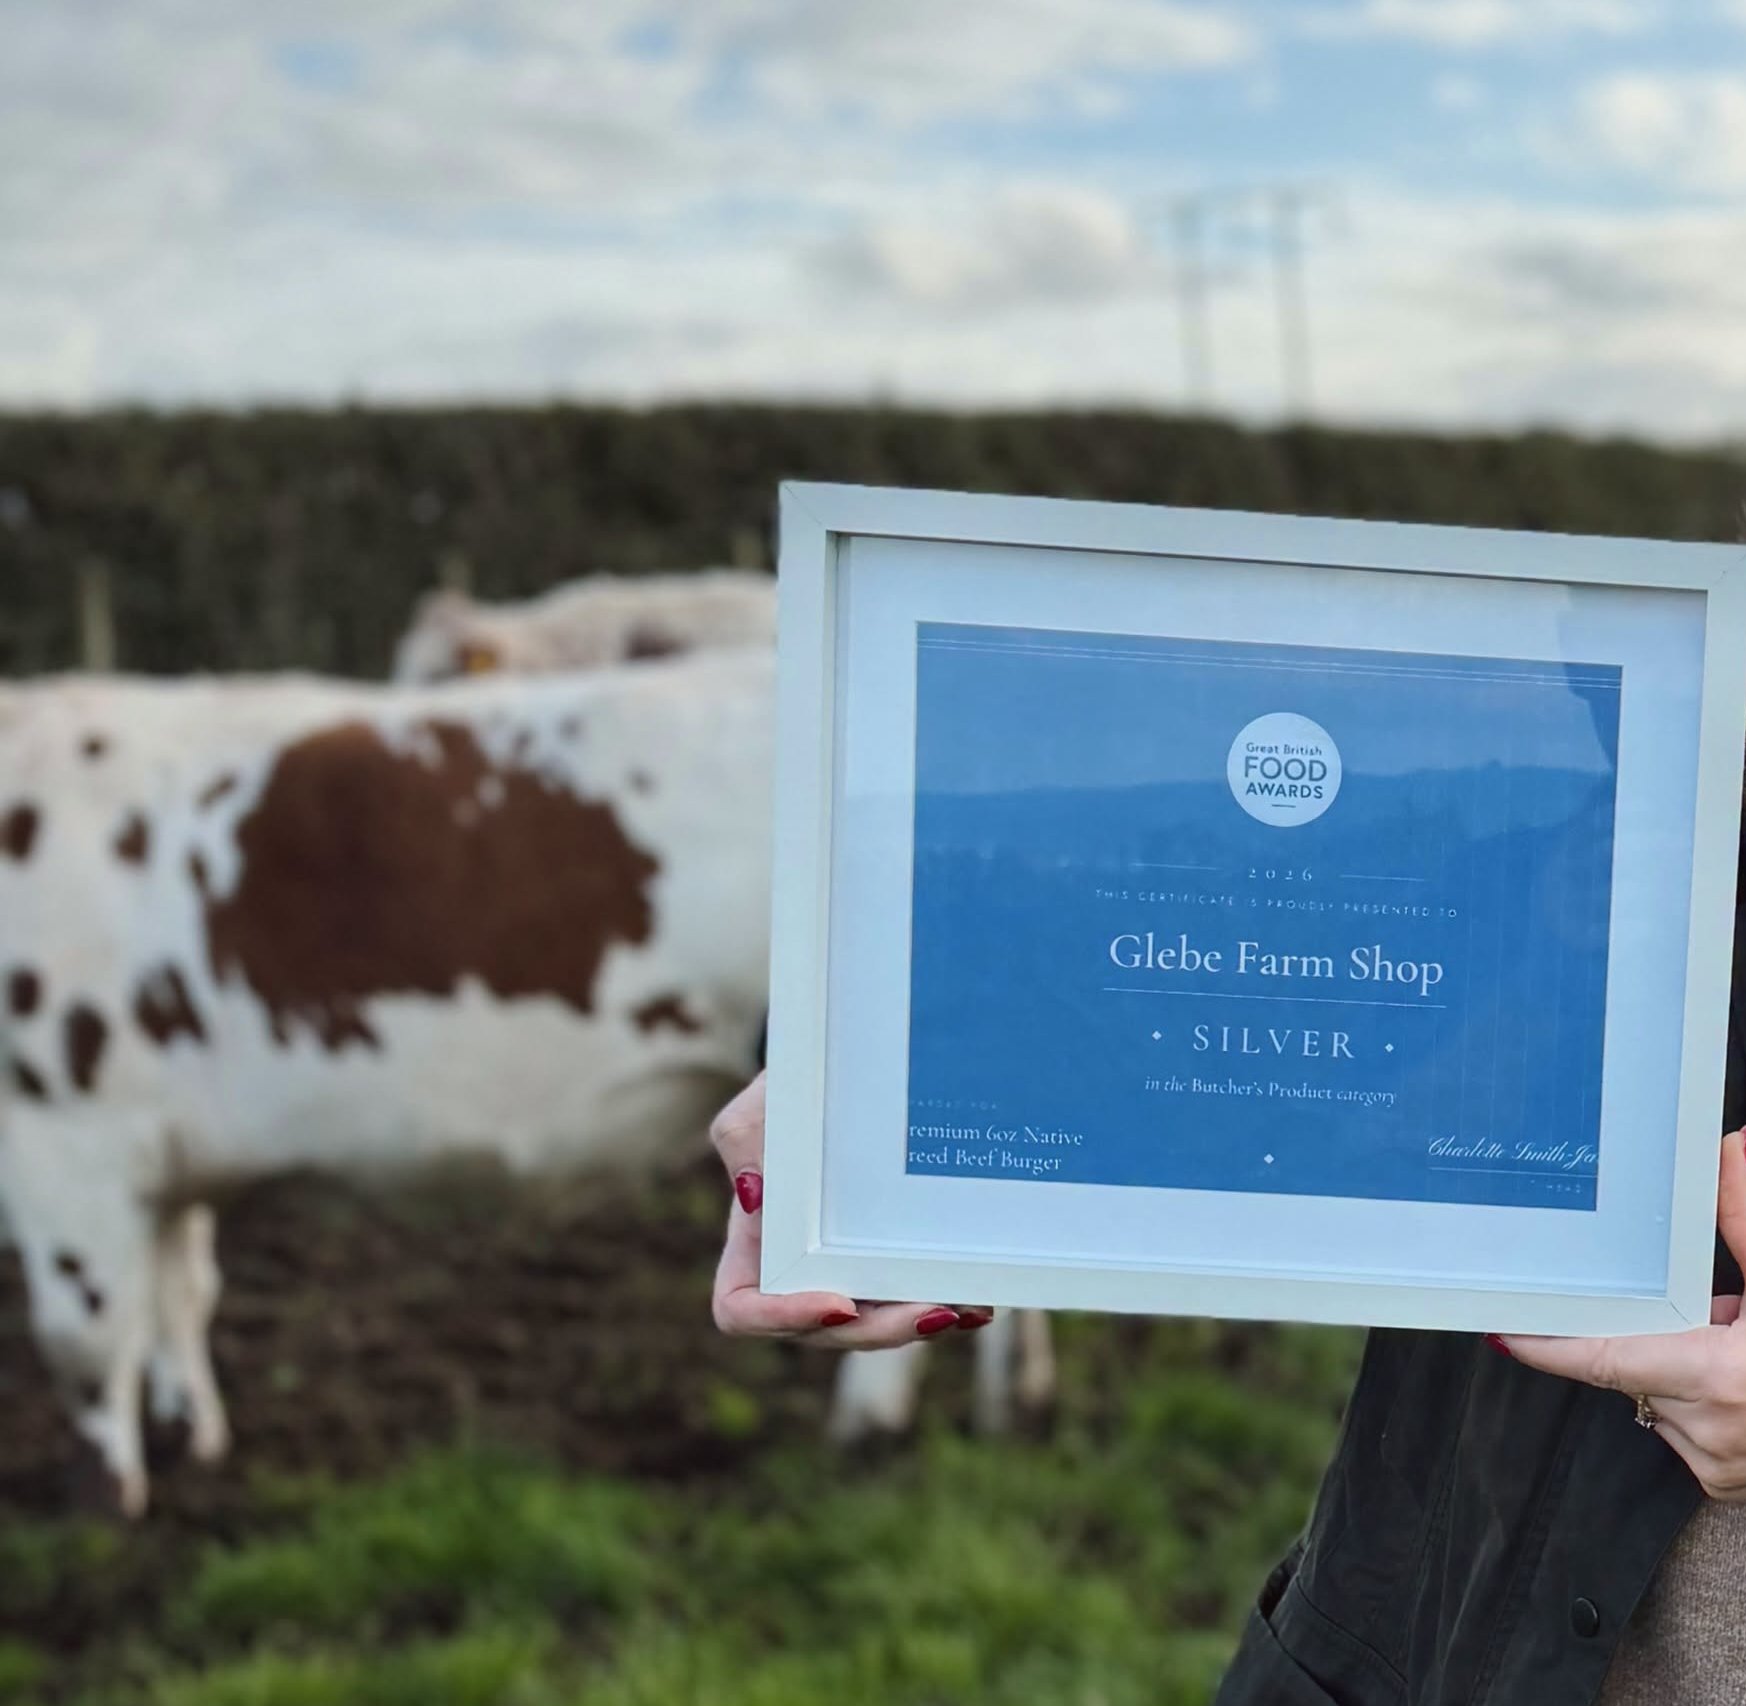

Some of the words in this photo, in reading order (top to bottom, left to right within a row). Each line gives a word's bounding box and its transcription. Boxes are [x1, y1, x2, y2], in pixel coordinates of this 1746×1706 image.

[1246, 742, 1279, 753] Great
[1283, 744, 1323, 756] British
[1244, 755, 1328, 782] FOOD
[1246, 782, 1324, 799] AWARDS
[1249, 868, 1313, 882] 2026
[1095, 888, 1129, 900] THIS
[1110, 932, 1223, 973] Glebe
[1236, 941, 1335, 979] Farm
[1350, 944, 1444, 997] Shop
[1192, 1024, 1356, 1059] SILVER
[1144, 1076, 1160, 1091] in
[1164, 1075, 1188, 1092] the
[1192, 1077, 1264, 1097] Butcher's
[1268, 1082, 1333, 1101] Product
[1336, 1088, 1398, 1108] category
[909, 1123, 981, 1141] remium
[986, 1125, 1018, 1142] 6oz
[1023, 1126, 1084, 1146] Native
[908, 1146, 948, 1164] reed
[955, 1148, 998, 1167] Beef
[1001, 1151, 1064, 1176] Burger
[1428, 1135, 1504, 1160] Charlotte
[1511, 1141, 1597, 1170] Smith-Ja
